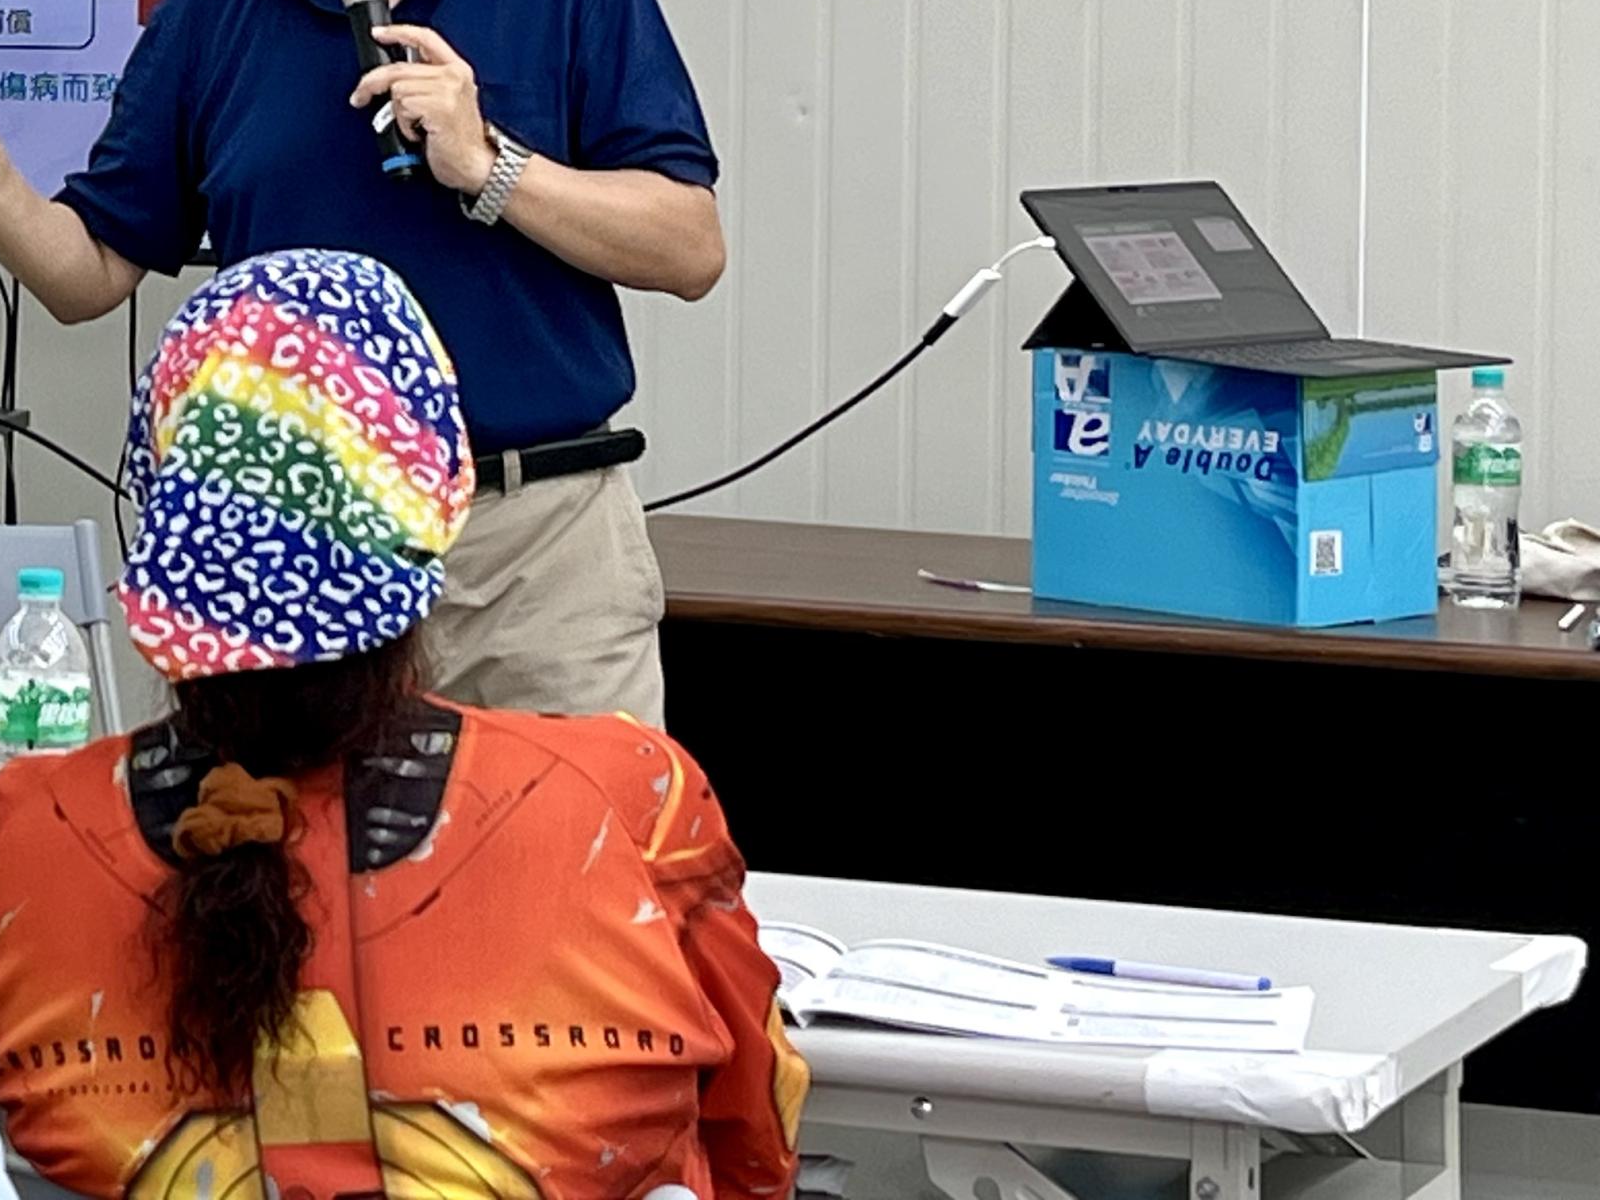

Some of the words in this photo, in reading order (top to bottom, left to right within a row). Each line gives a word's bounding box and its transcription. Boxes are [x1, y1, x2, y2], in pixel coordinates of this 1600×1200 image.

[1137, 420, 1279, 453] EVERYDAY
[1133, 443, 1155, 470] A
[1166, 446, 1273, 481] Double
